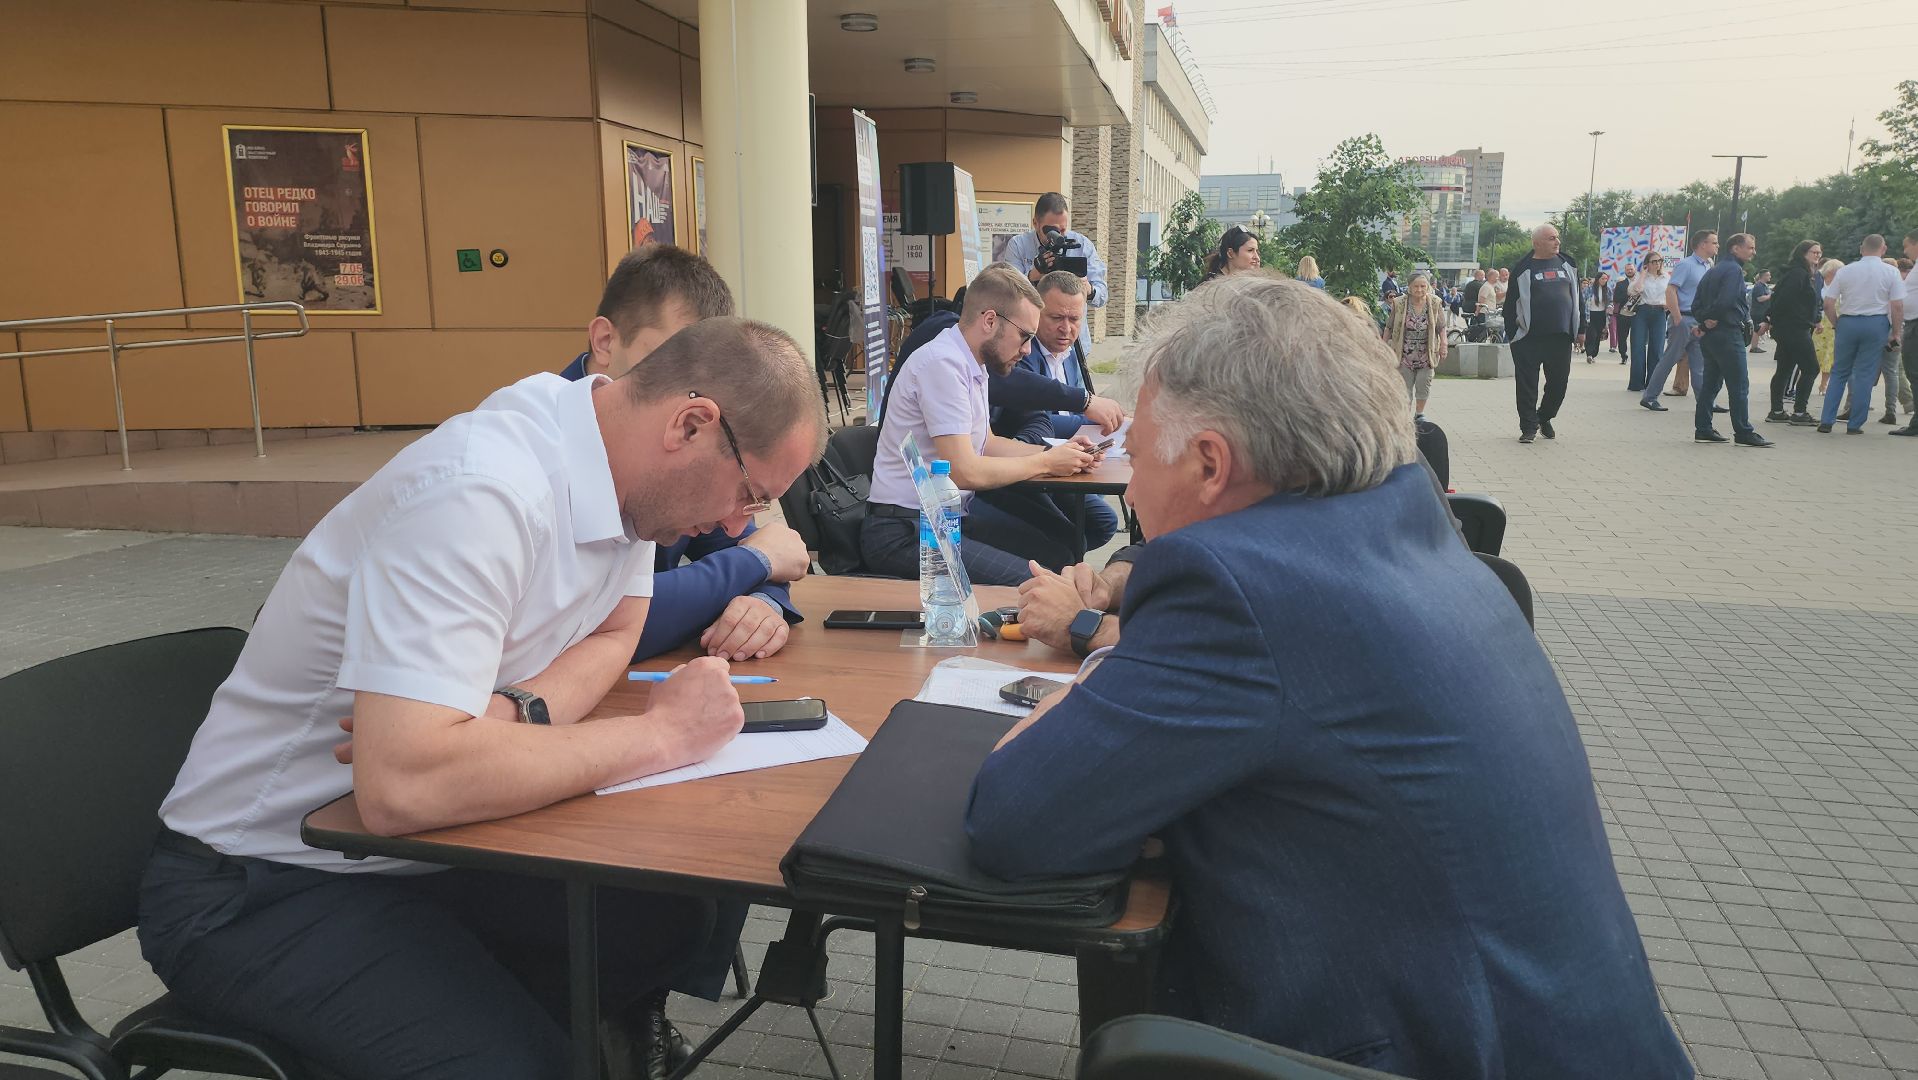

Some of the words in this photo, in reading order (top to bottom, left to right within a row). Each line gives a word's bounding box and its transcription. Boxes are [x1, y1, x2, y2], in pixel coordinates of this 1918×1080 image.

[244, 186, 275, 200] ОТЕЦ
[277, 187, 316, 201] РЕДКО
[245, 201, 300, 213] ГОВОРИЛ
[247, 215, 256, 227] О
[257, 212, 297, 227] ВОЙНЕ
[882, 215, 898, 224] ЕМЯ
